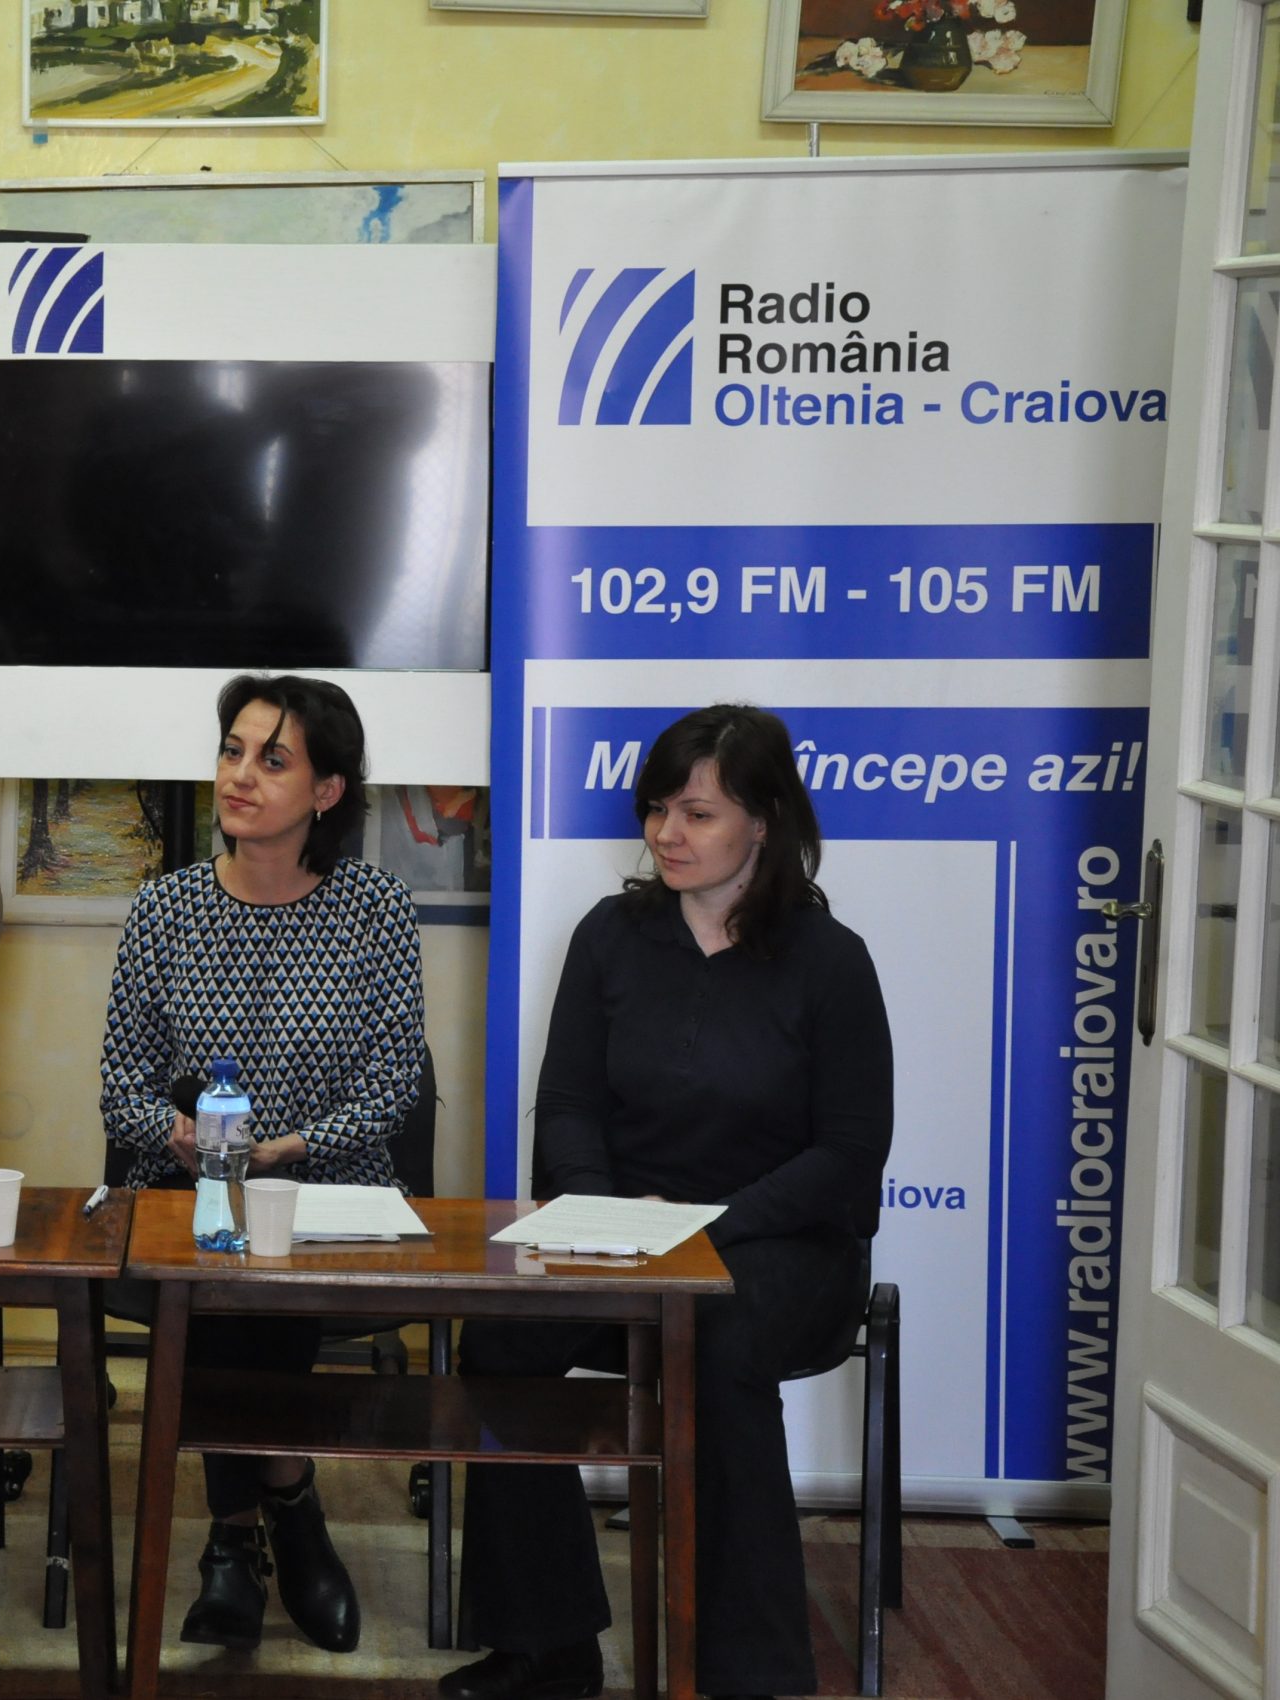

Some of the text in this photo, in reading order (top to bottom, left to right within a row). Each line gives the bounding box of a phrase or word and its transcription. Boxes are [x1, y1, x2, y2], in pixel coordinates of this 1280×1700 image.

[719, 282, 871, 325] Radio
[718, 331, 950, 374] România
[714, 380, 1167, 427] Oltenia - Craiova
[571, 565, 1101, 623] 102,9 FM - 105 FM
[793, 740, 1142, 803] începe azi!
[1056, 845, 1120, 1484] www.radiocraiova.ro
[880, 1178, 966, 1210] iova
